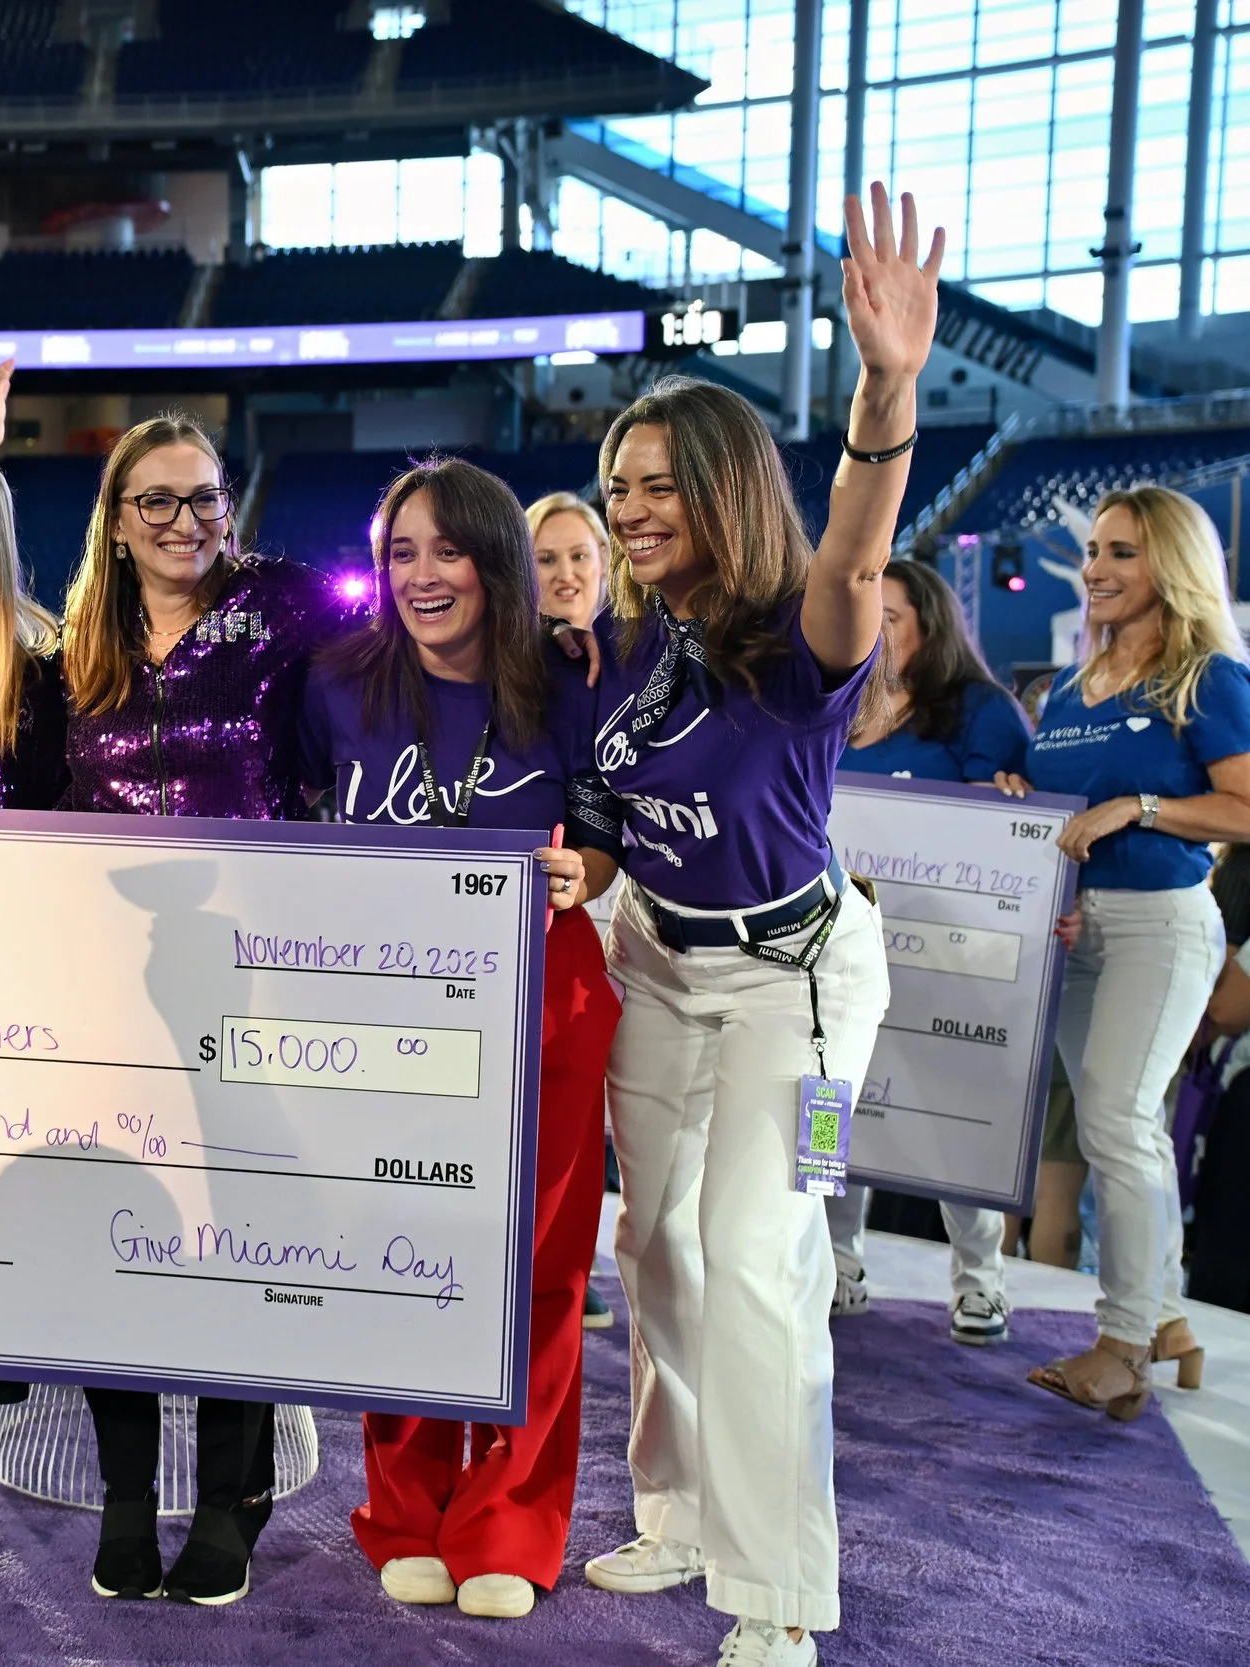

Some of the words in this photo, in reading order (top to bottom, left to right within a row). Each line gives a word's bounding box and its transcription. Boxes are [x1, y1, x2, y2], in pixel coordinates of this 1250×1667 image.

[1050, 725, 1081, 740] With
[1084, 723, 1121, 736] Love
[423, 769, 438, 802] Miami
[465, 756, 481, 789] Miami
[1010, 821, 1053, 840] 1967
[451, 873, 509, 896] 1967
[844, 848, 950, 884] November
[990, 869, 1040, 895] 2025
[767, 922, 801, 938] Miami
[234, 930, 365, 968] November
[758, 946, 792, 963] Miami
[932, 1017, 1008, 1043] DOLLARS
[199, 1033, 217, 1063] $
[816, 1087, 836, 1099] SCAN
[46, 1121, 99, 1151] and
[374, 1158, 474, 1184] DOLLARS
[110, 1209, 186, 1267] Give
[197, 1223, 358, 1271] Miami
[381, 1235, 464, 1309] Day
